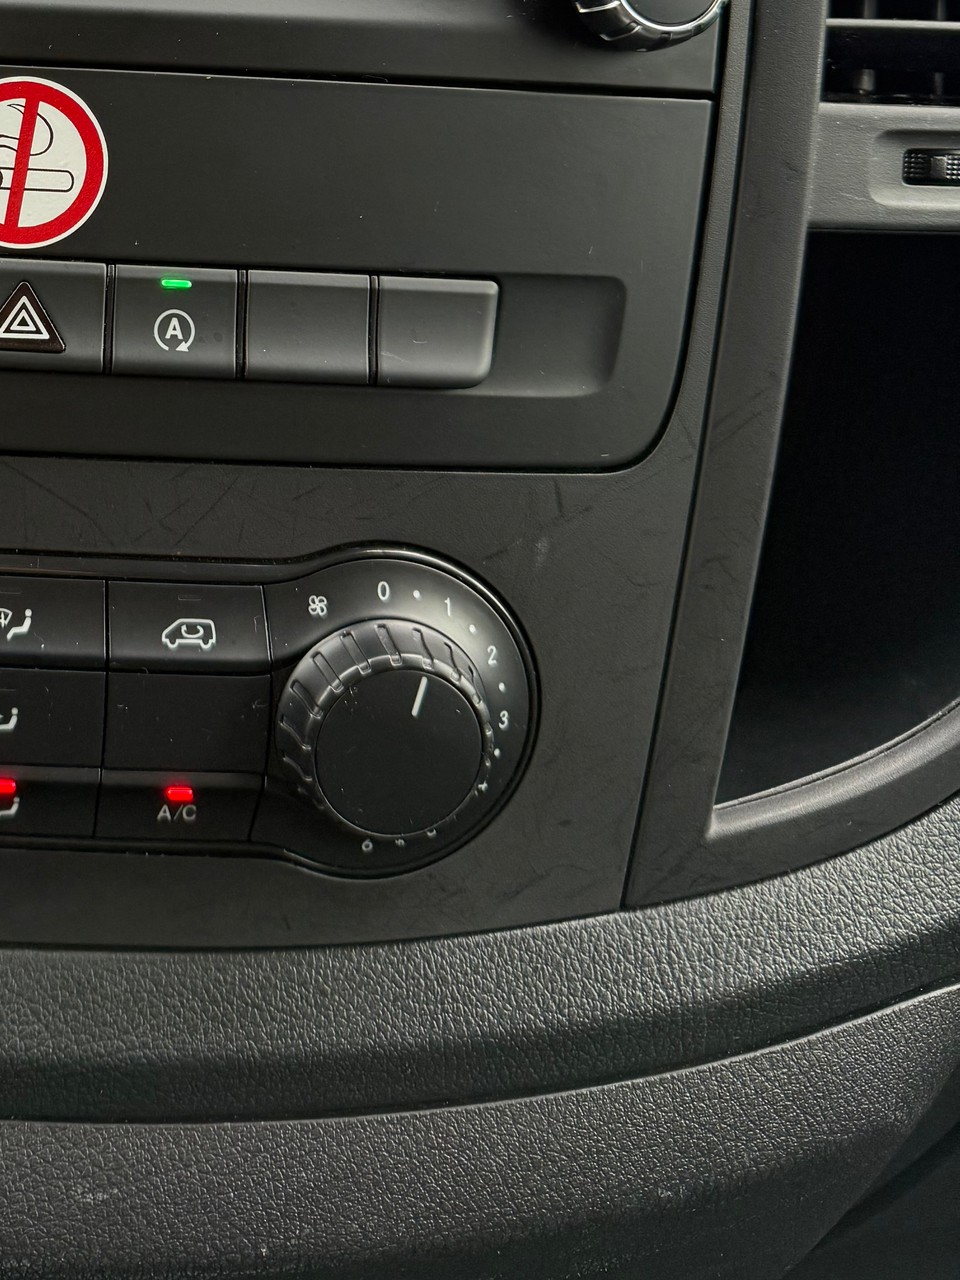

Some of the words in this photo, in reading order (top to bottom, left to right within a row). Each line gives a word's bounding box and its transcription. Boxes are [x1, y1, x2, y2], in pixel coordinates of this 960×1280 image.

[164, 317, 184, 340] A
[377, 581, 390, 602] 0
[444, 597, 452, 617] 1
[487, 645, 498, 666] 2
[498, 711, 509, 732] 3
[156, 804, 197, 822] A/C
